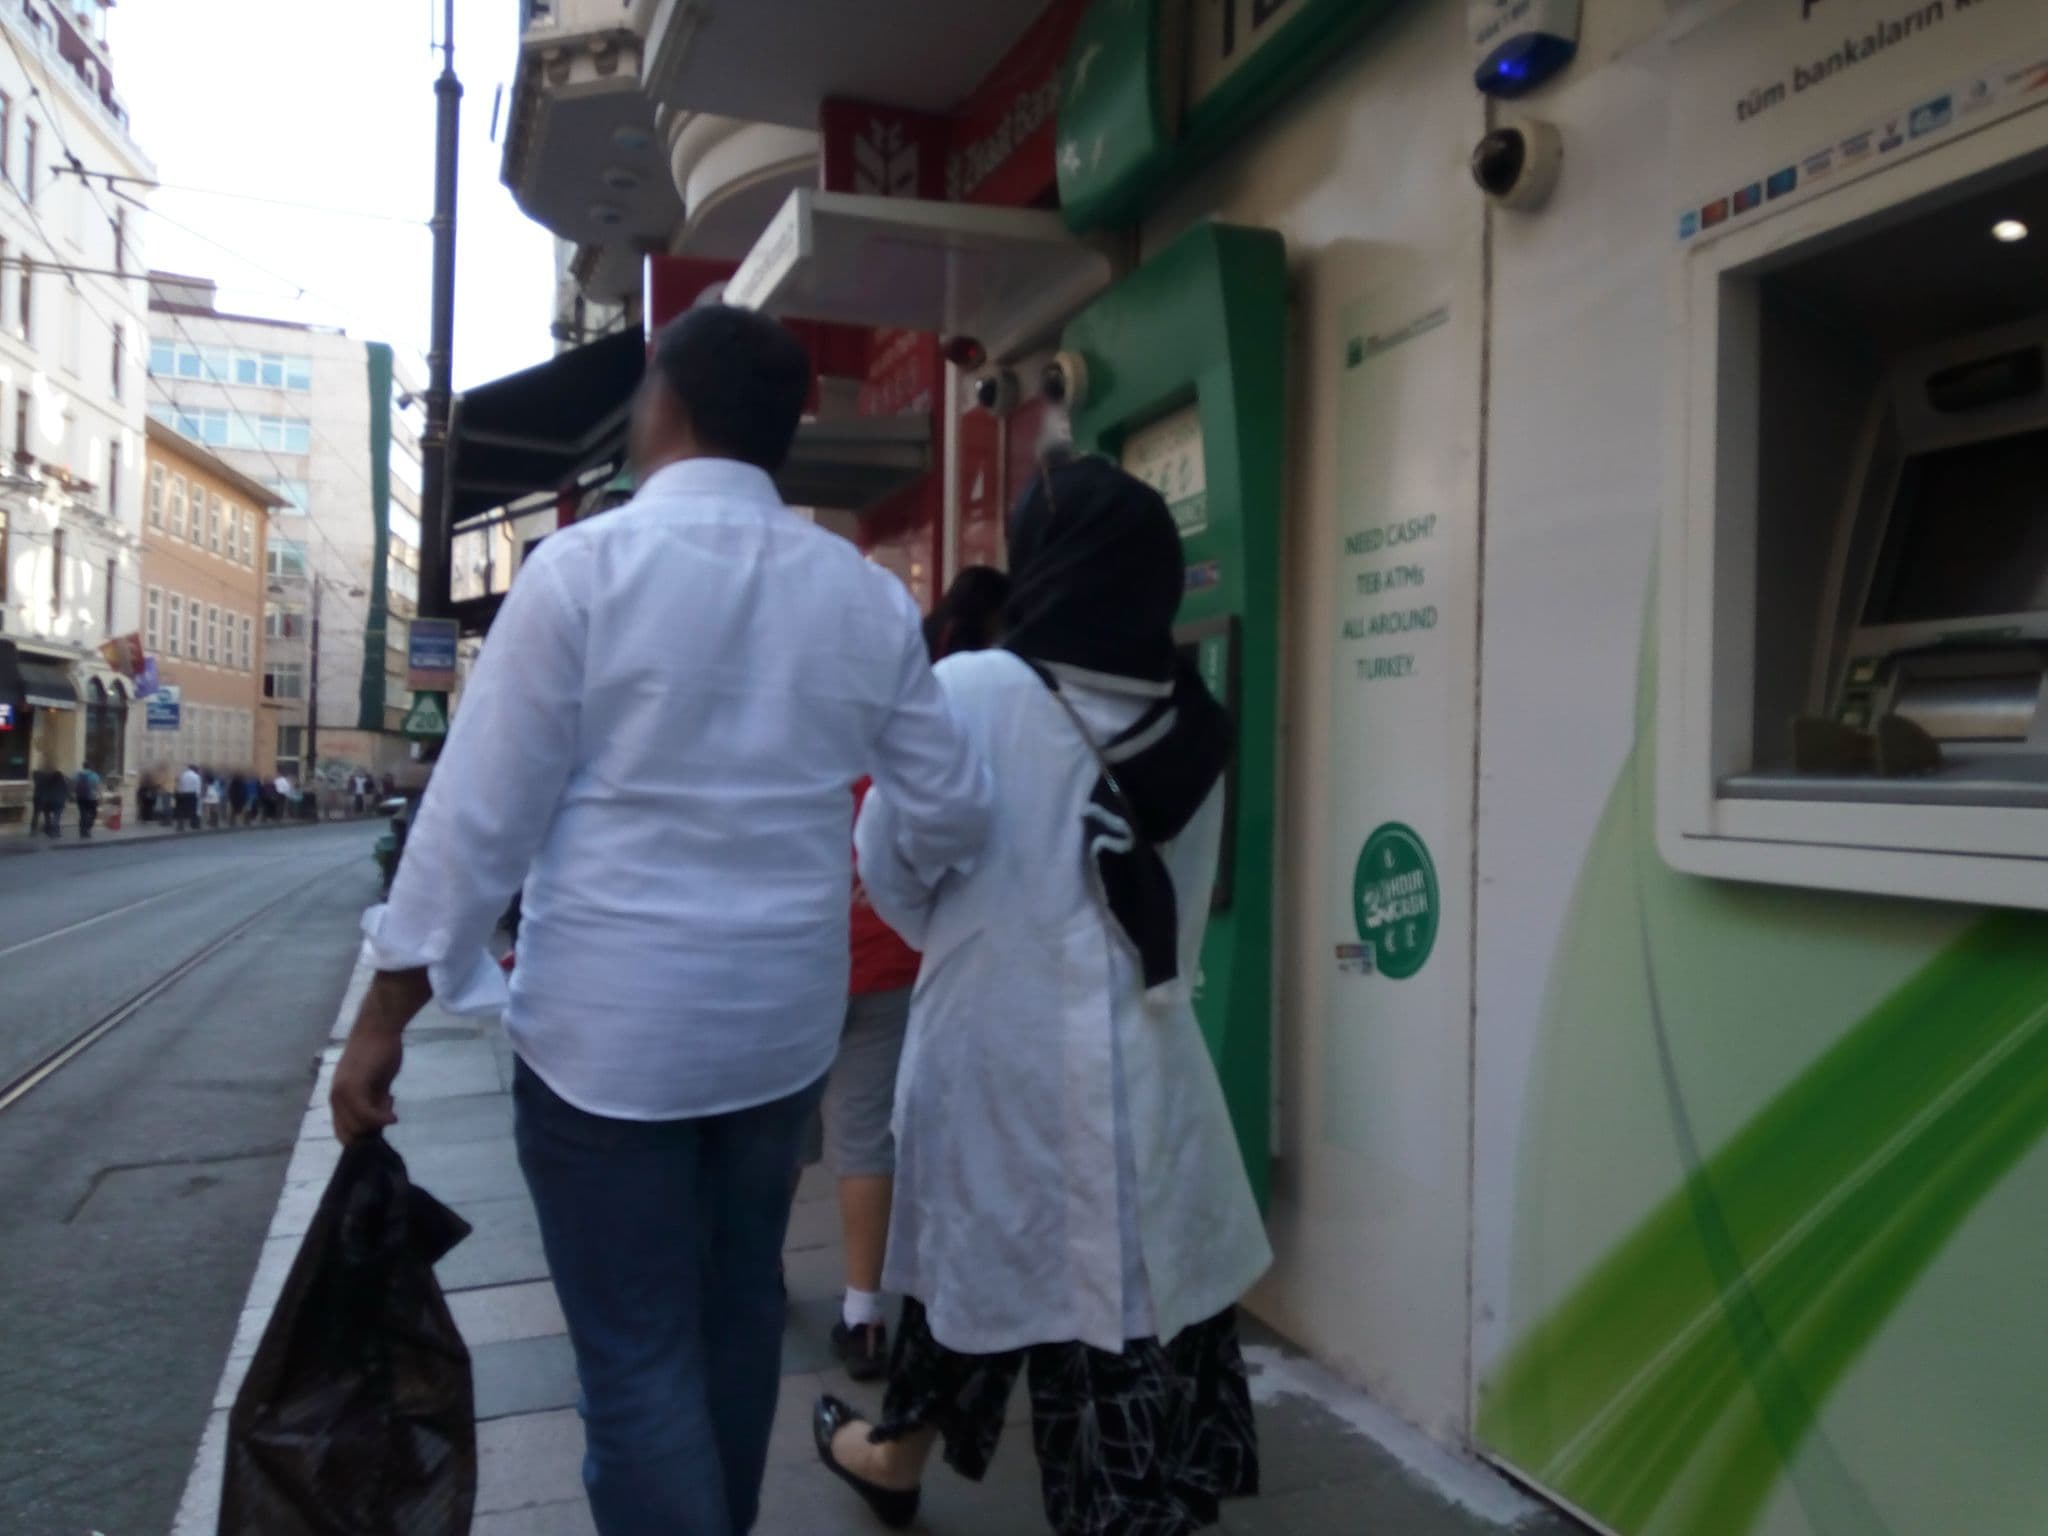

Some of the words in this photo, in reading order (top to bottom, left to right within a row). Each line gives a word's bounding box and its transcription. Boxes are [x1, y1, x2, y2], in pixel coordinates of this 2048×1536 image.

[1736, 80, 1786, 121] tüm
[1344, 527, 1384, 556] NEED
[1386, 513, 1438, 547] CASH?
[1342, 615, 1365, 640] ALL
[1367, 605, 1439, 636] AROUND
